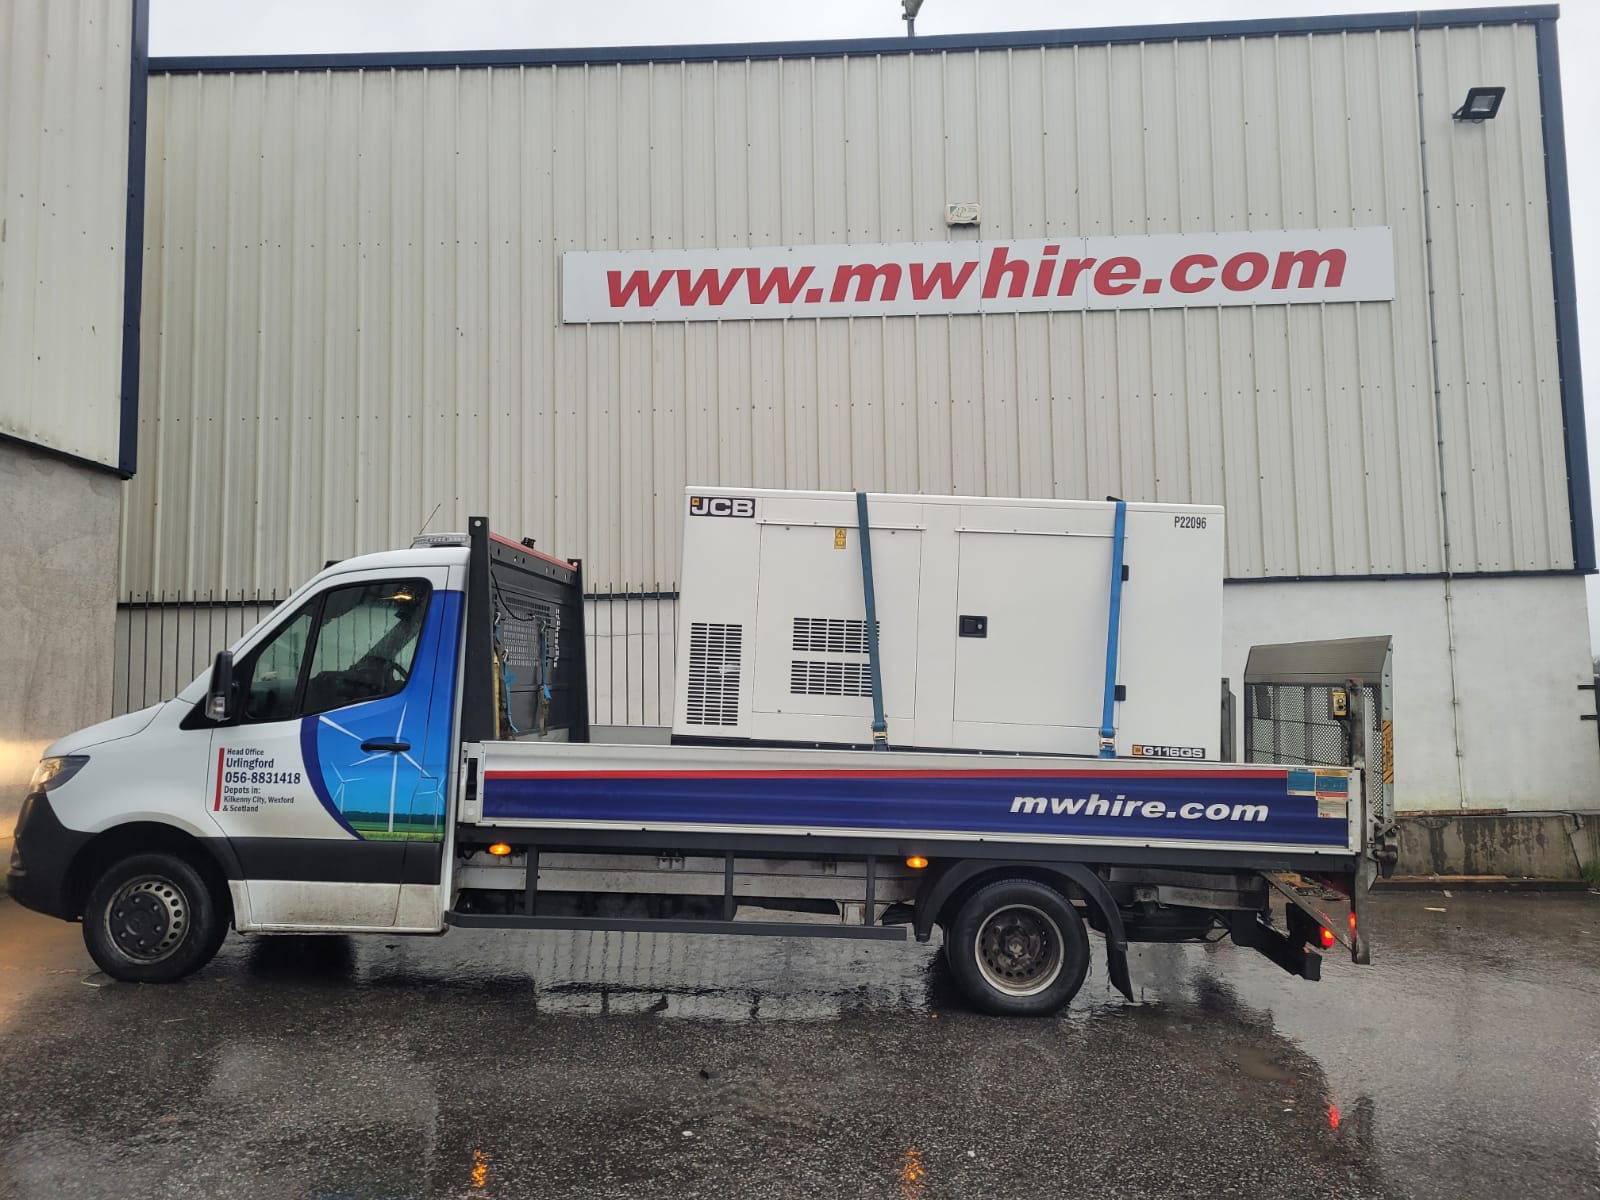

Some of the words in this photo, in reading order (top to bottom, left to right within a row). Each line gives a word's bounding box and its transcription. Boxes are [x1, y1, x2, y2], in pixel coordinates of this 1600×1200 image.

[606, 245, 1347, 308] www.mwhire.com
[692, 498, 753, 516] JCB
[1174, 516, 1207, 529] P22096
[227, 748, 244, 756] Head
[245, 748, 264, 756] Office
[226, 758, 274, 770] Urlingford
[225, 771, 301, 784] 056-8831418
[224, 785, 250, 795] Depots
[251, 786, 261, 794] in:
[224, 796, 251, 804] Kilkenny
[252, 796, 267, 805] City,
[268, 796, 294, 804] Wexford
[222, 804, 229, 812] &
[229, 804, 259, 812] Scotland
[1010, 793, 1269, 822] mwhire.com
